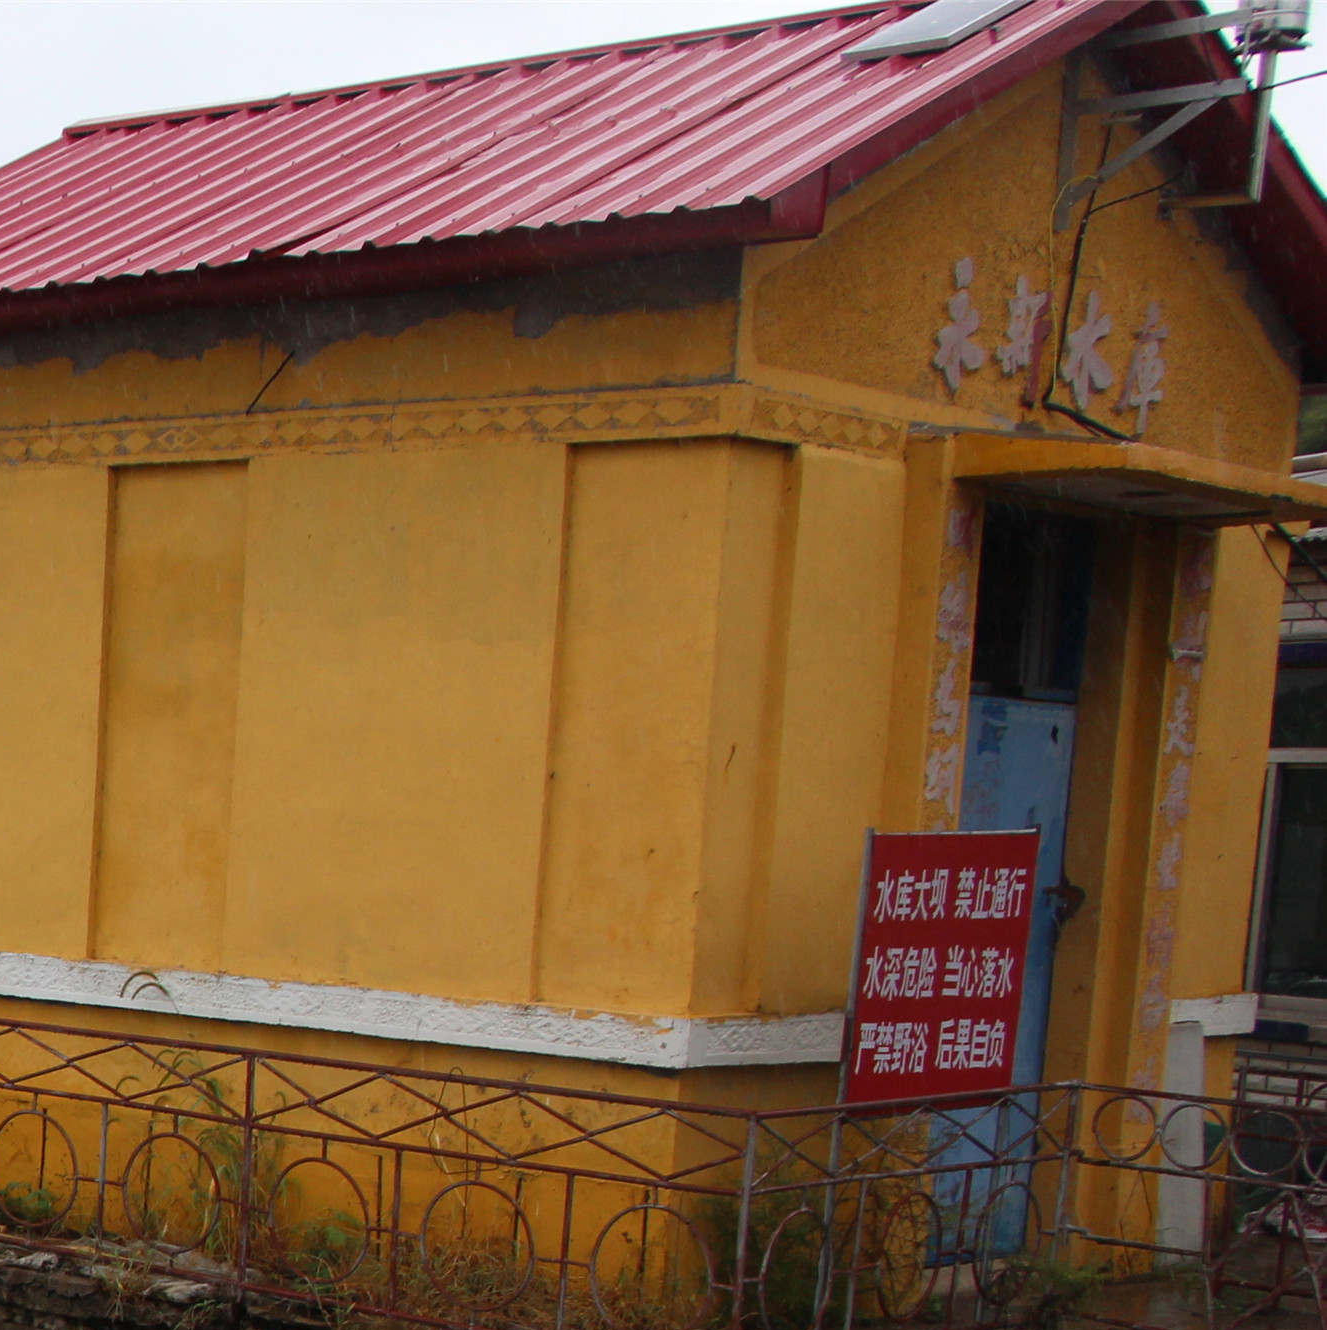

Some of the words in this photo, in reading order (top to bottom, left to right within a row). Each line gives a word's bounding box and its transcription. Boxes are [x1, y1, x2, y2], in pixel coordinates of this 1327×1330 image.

[873, 868, 949, 923] 水库大坝
[954, 867, 1028, 920] 禁止通行
[862, 945, 938, 1001] 水深危险
[941, 944, 1014, 999] 当心落水
[854, 1021, 929, 1075] 严禁野浴
[935, 1018, 1006, 1070] 后果自负
